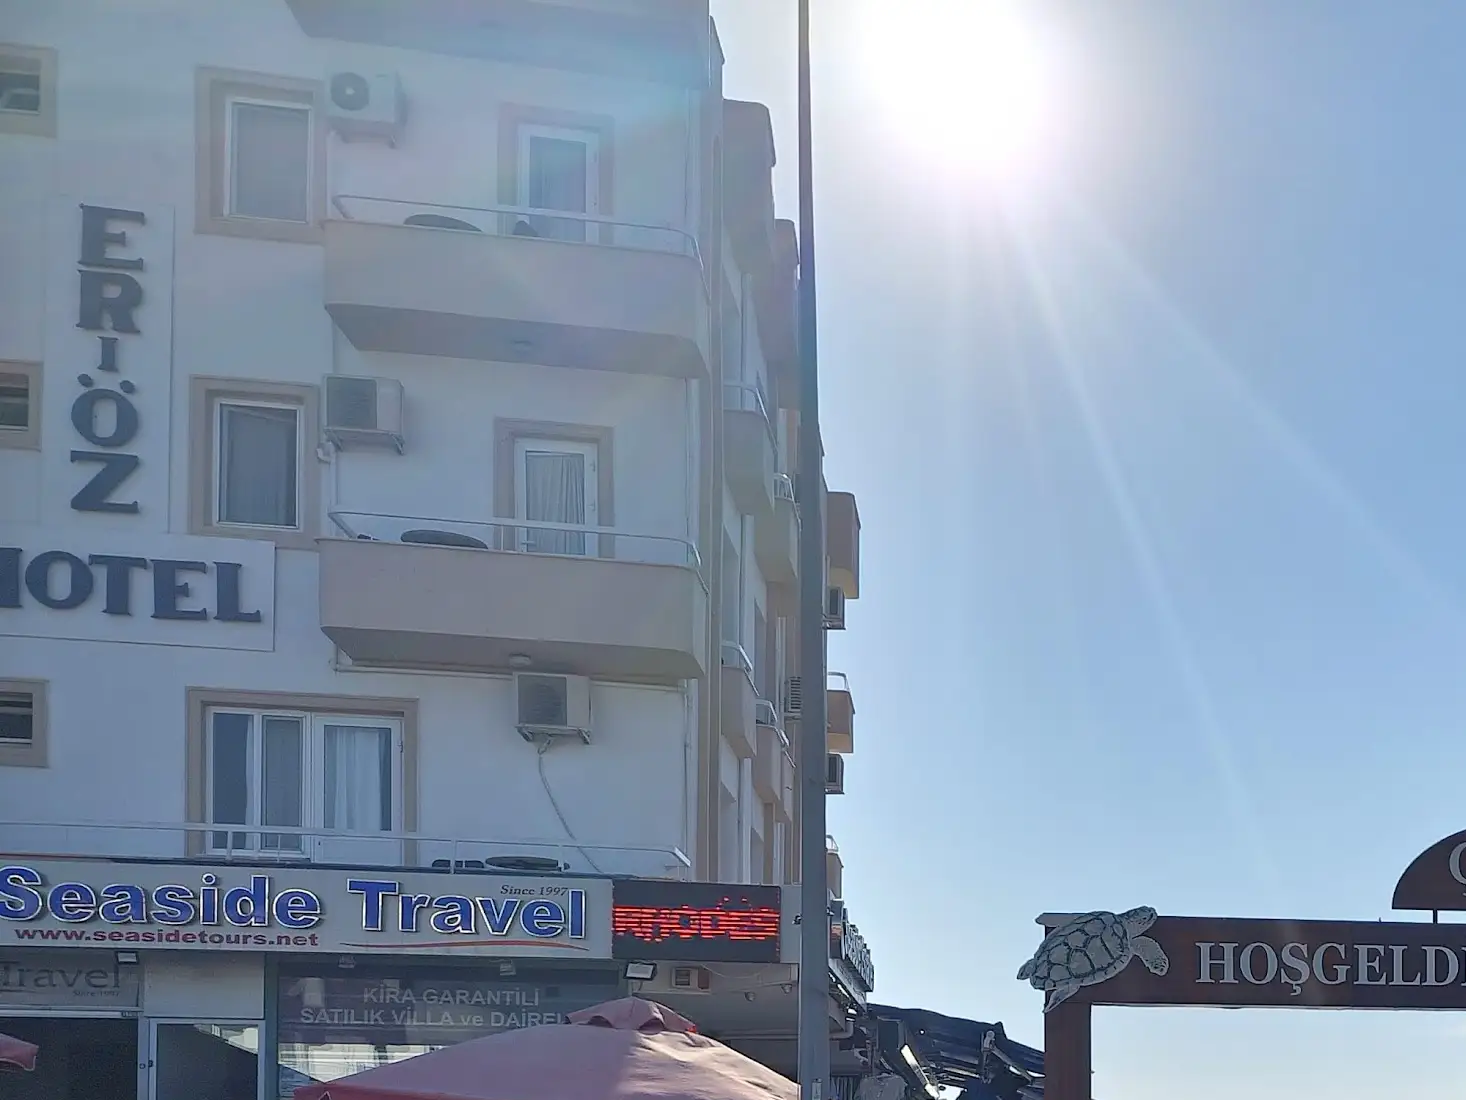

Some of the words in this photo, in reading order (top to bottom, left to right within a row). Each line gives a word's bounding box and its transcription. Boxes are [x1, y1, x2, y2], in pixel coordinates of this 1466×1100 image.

[500, 884, 536, 896] Since
[538, 886, 569, 897] 1997
[0, 865, 323, 930] Seaside
[346, 877, 588, 940] Travel
[14, 927, 319, 947] www.seasidetours.net
[363, 984, 417, 1005] KİRA
[422, 986, 540, 1007] GARANTİLİ
[299, 1007, 386, 1026] SATILIK
[391, 1007, 455, 1027] VİLLA
[459, 1012, 483, 1028] ve
